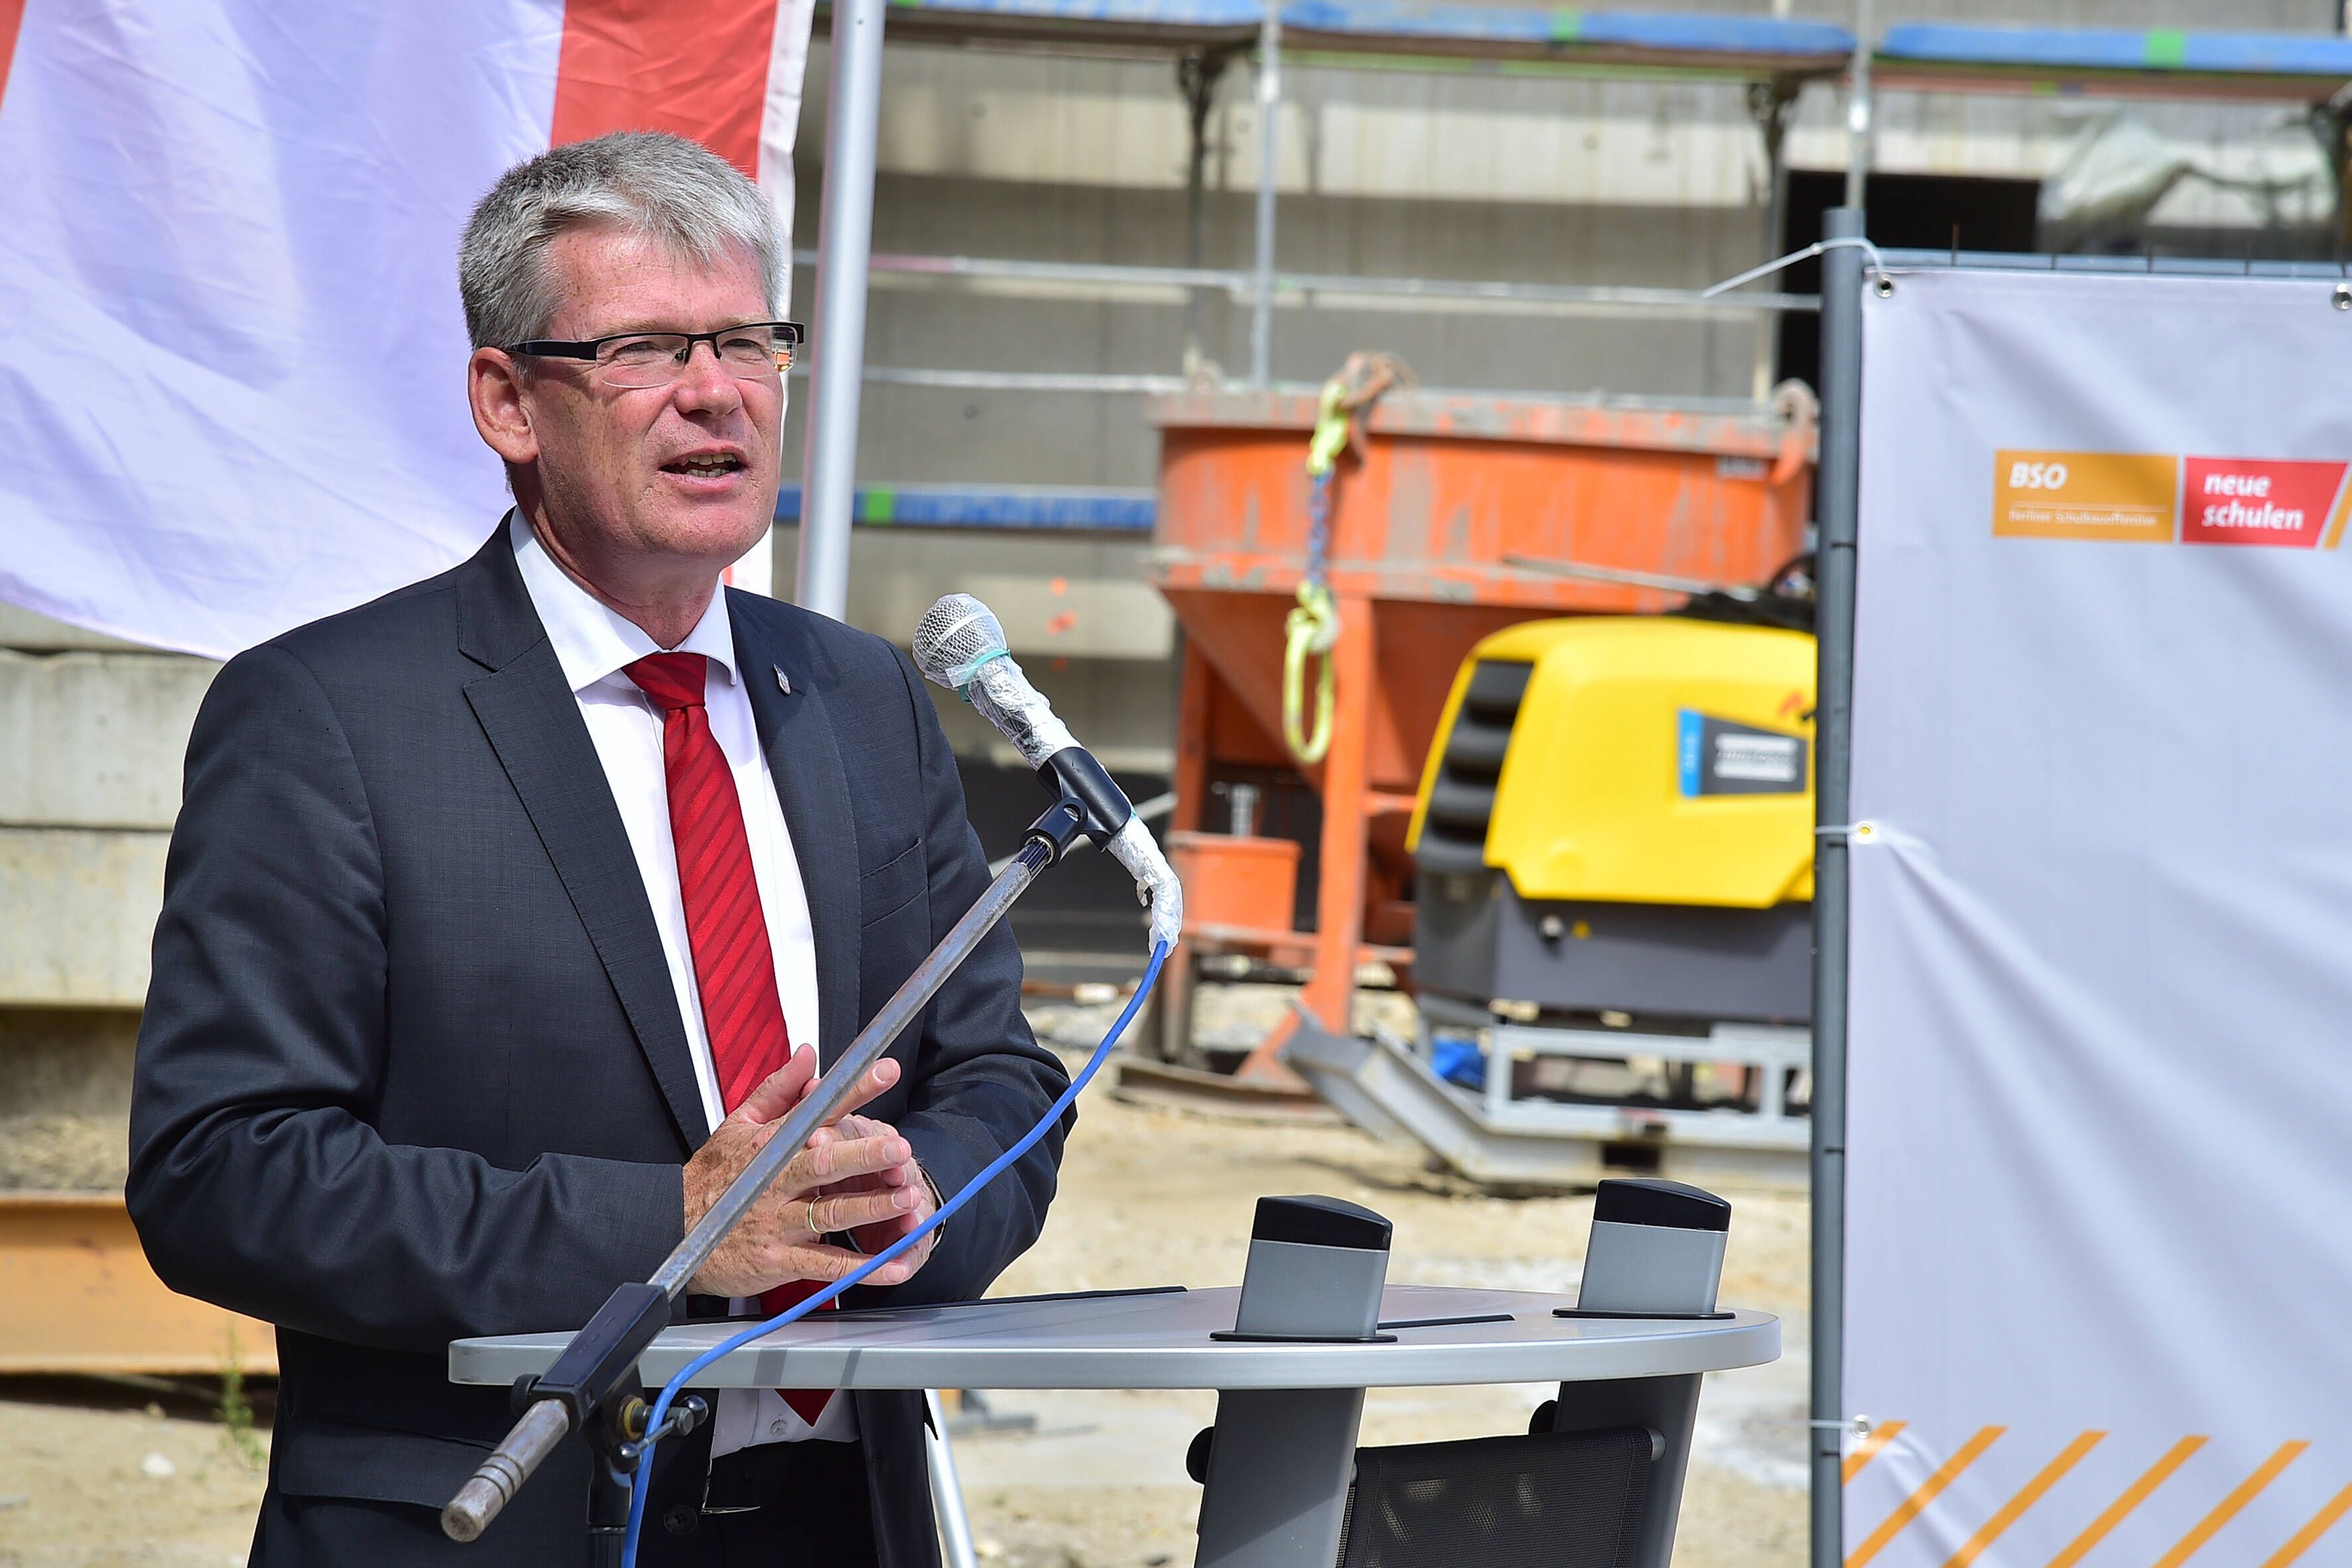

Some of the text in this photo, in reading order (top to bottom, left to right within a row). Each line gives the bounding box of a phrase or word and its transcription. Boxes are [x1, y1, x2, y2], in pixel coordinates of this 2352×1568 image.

[2009, 461, 2068, 490] BSO
[2203, 472, 2271, 498] neue
[2201, 500, 2304, 530] schulen
